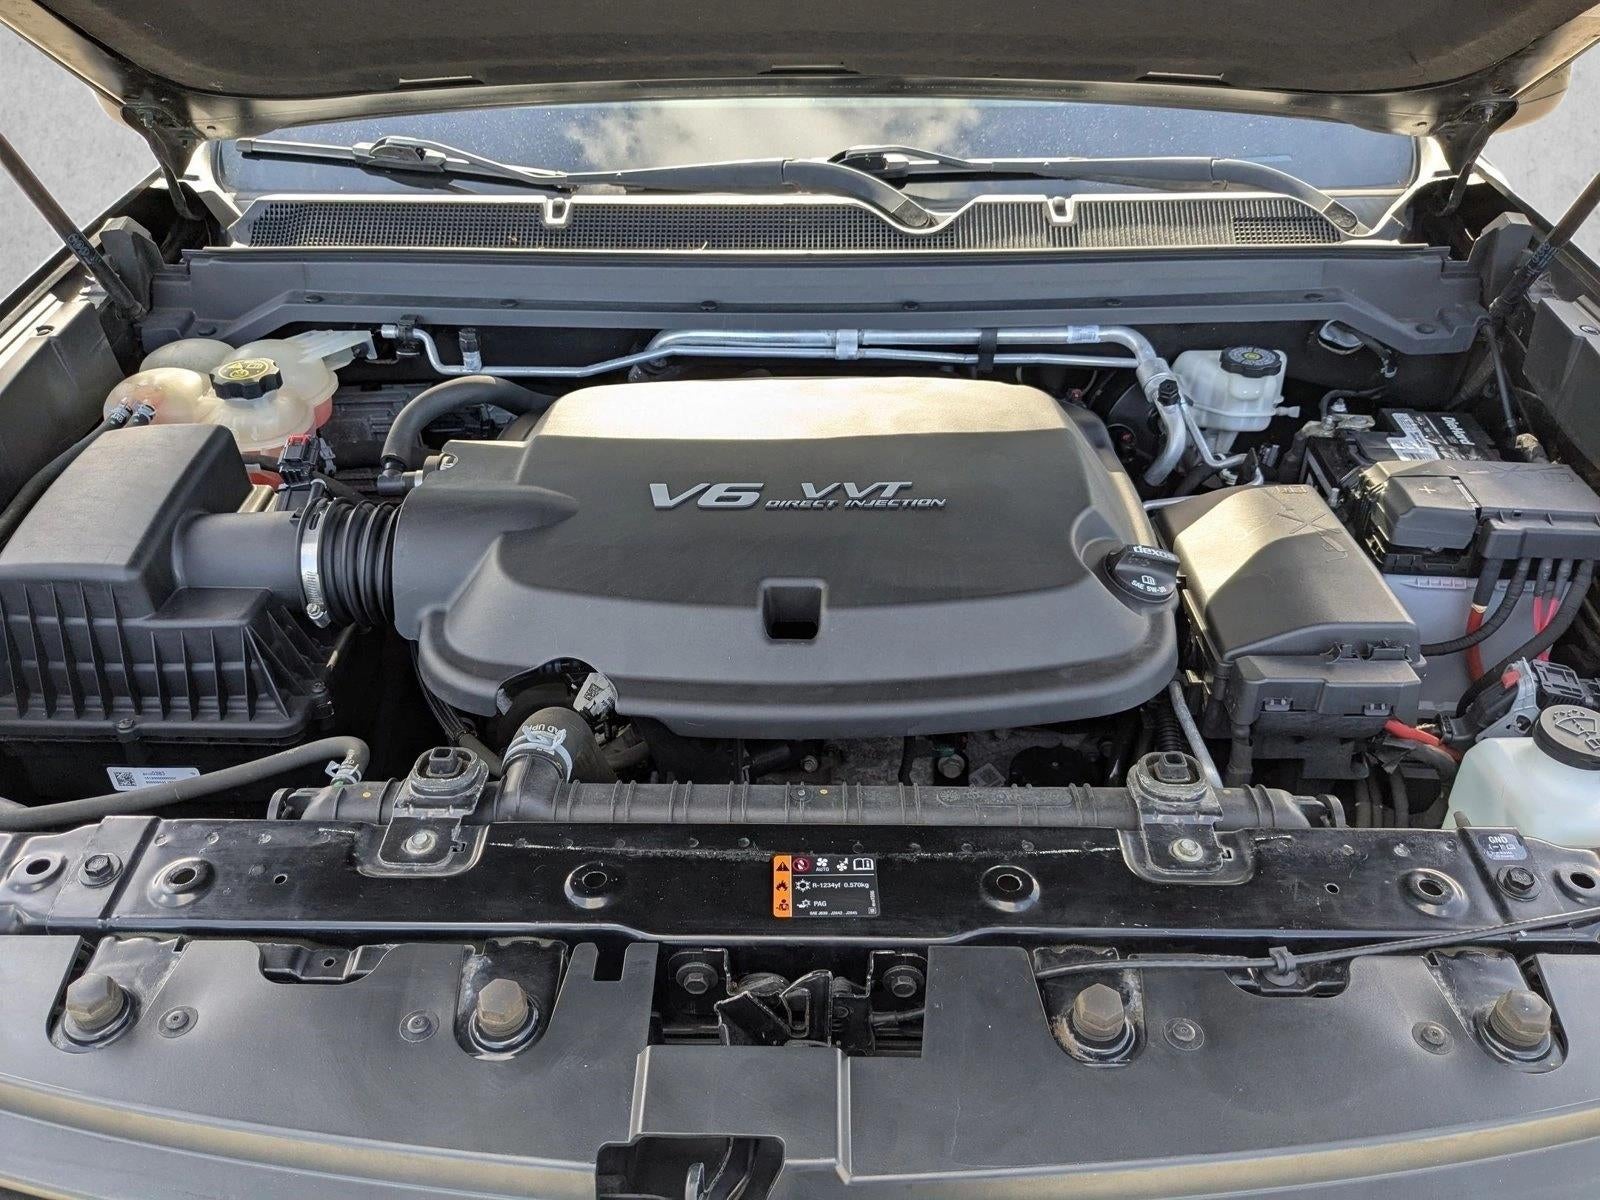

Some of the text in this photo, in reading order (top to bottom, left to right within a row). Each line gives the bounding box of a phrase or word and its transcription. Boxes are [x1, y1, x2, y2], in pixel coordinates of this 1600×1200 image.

[649, 481, 913, 509] V6 VVT
[765, 498, 947, 511] DIRECT INJECTION
[1132, 545, 1177, 561] dexos
[1131, 580, 1145, 590] SAE
[1487, 835, 1509, 844] GND
